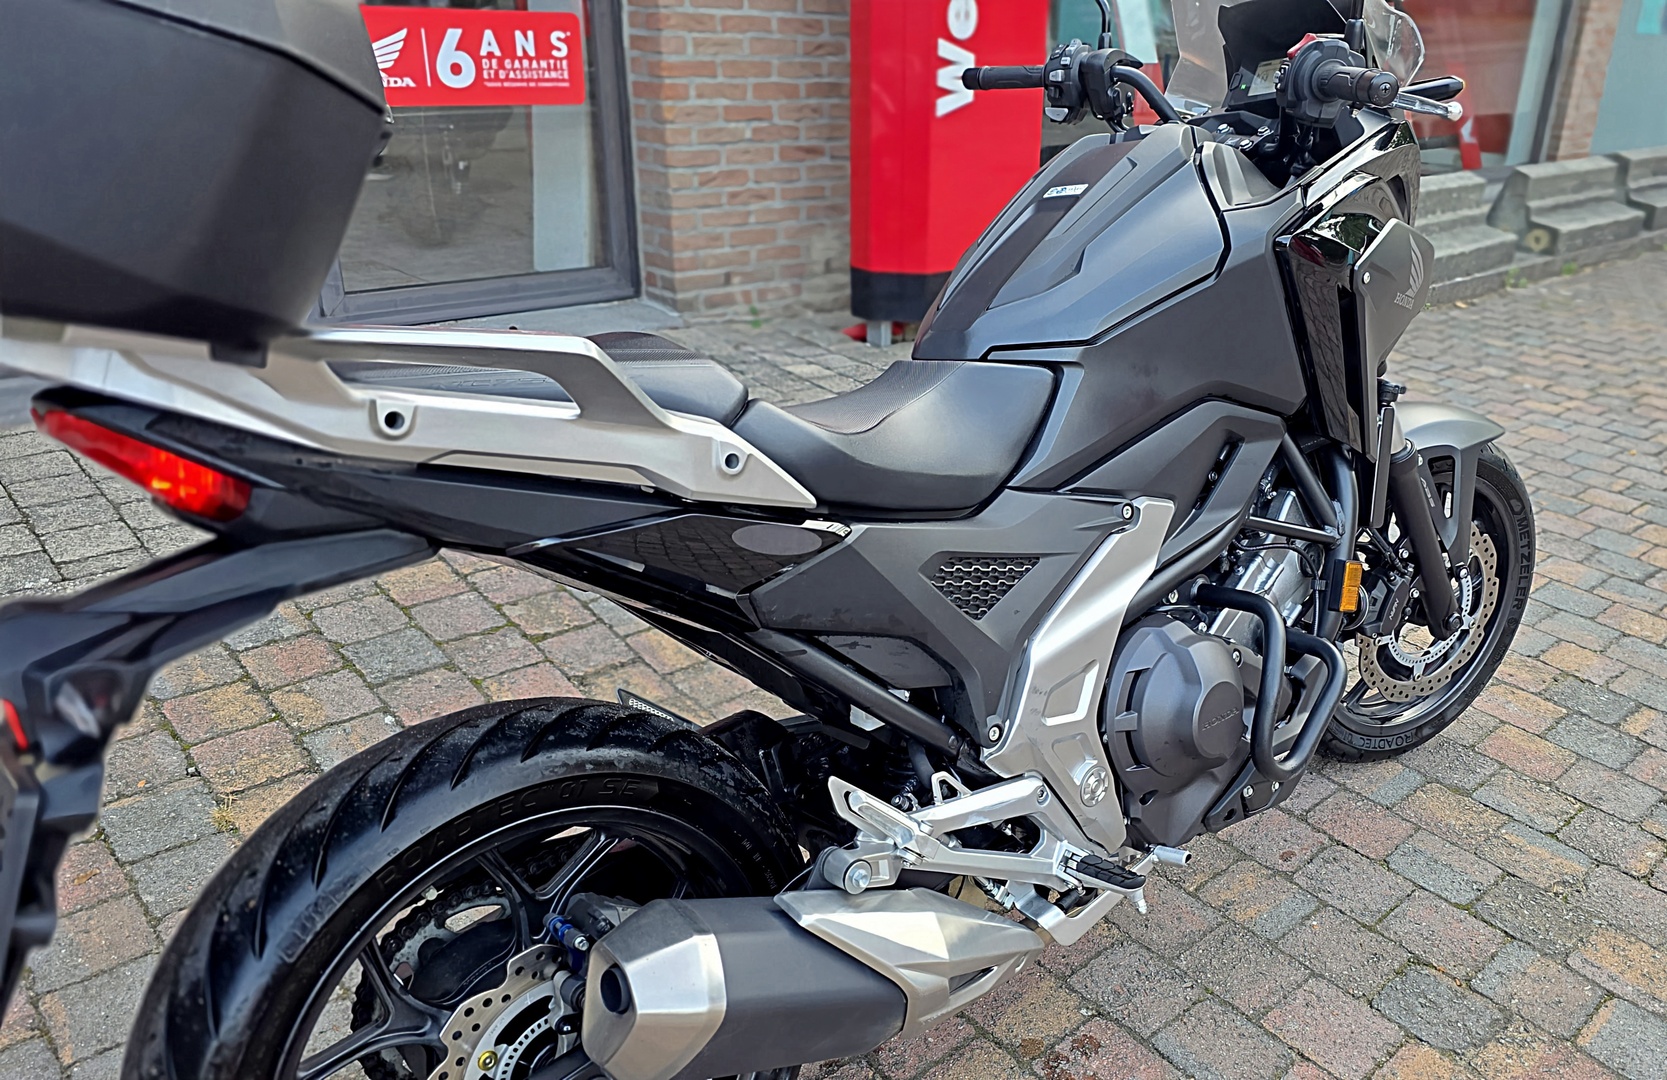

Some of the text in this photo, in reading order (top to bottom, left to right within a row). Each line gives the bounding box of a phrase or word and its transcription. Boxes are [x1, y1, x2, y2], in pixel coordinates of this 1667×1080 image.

[436, 28, 476, 89] 6
[481, 58, 569, 70] DE GARANTIE
[381, 76, 417, 88] NDA
[482, 69, 570, 80] ET D'ASSISTANCE
[1393, 292, 1415, 310] HONDA
[1513, 514, 1532, 612] METZELER
[1201, 707, 1240, 731] HONDA
[1359, 731, 1415, 750] ROADTEC
[598, 777, 642, 797] SE
